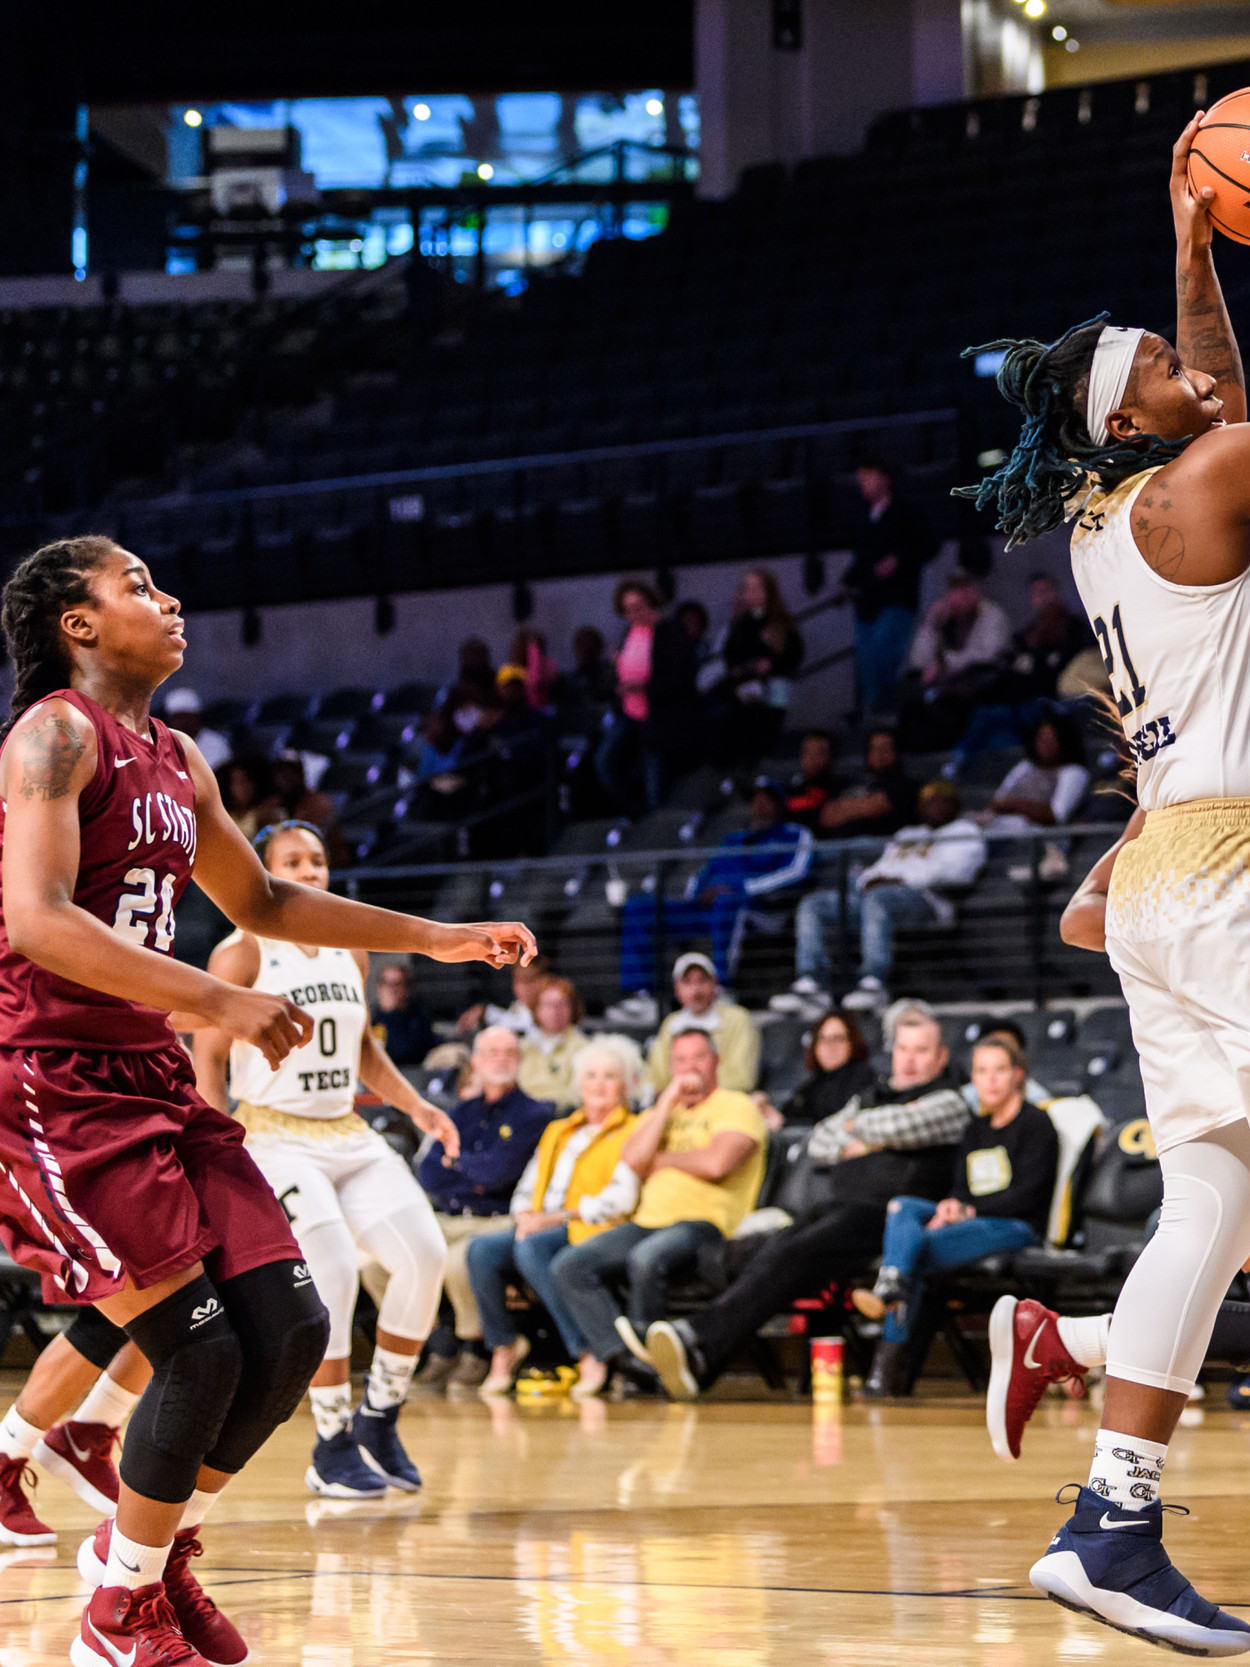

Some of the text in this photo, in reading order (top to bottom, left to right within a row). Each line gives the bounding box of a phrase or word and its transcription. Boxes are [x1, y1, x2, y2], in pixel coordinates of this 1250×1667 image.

[127, 792, 157, 851] SC
[281, 983, 361, 1006] EORGIA
[319, 1017, 337, 1057] 0
[298, 1069, 350, 1092] TECH
